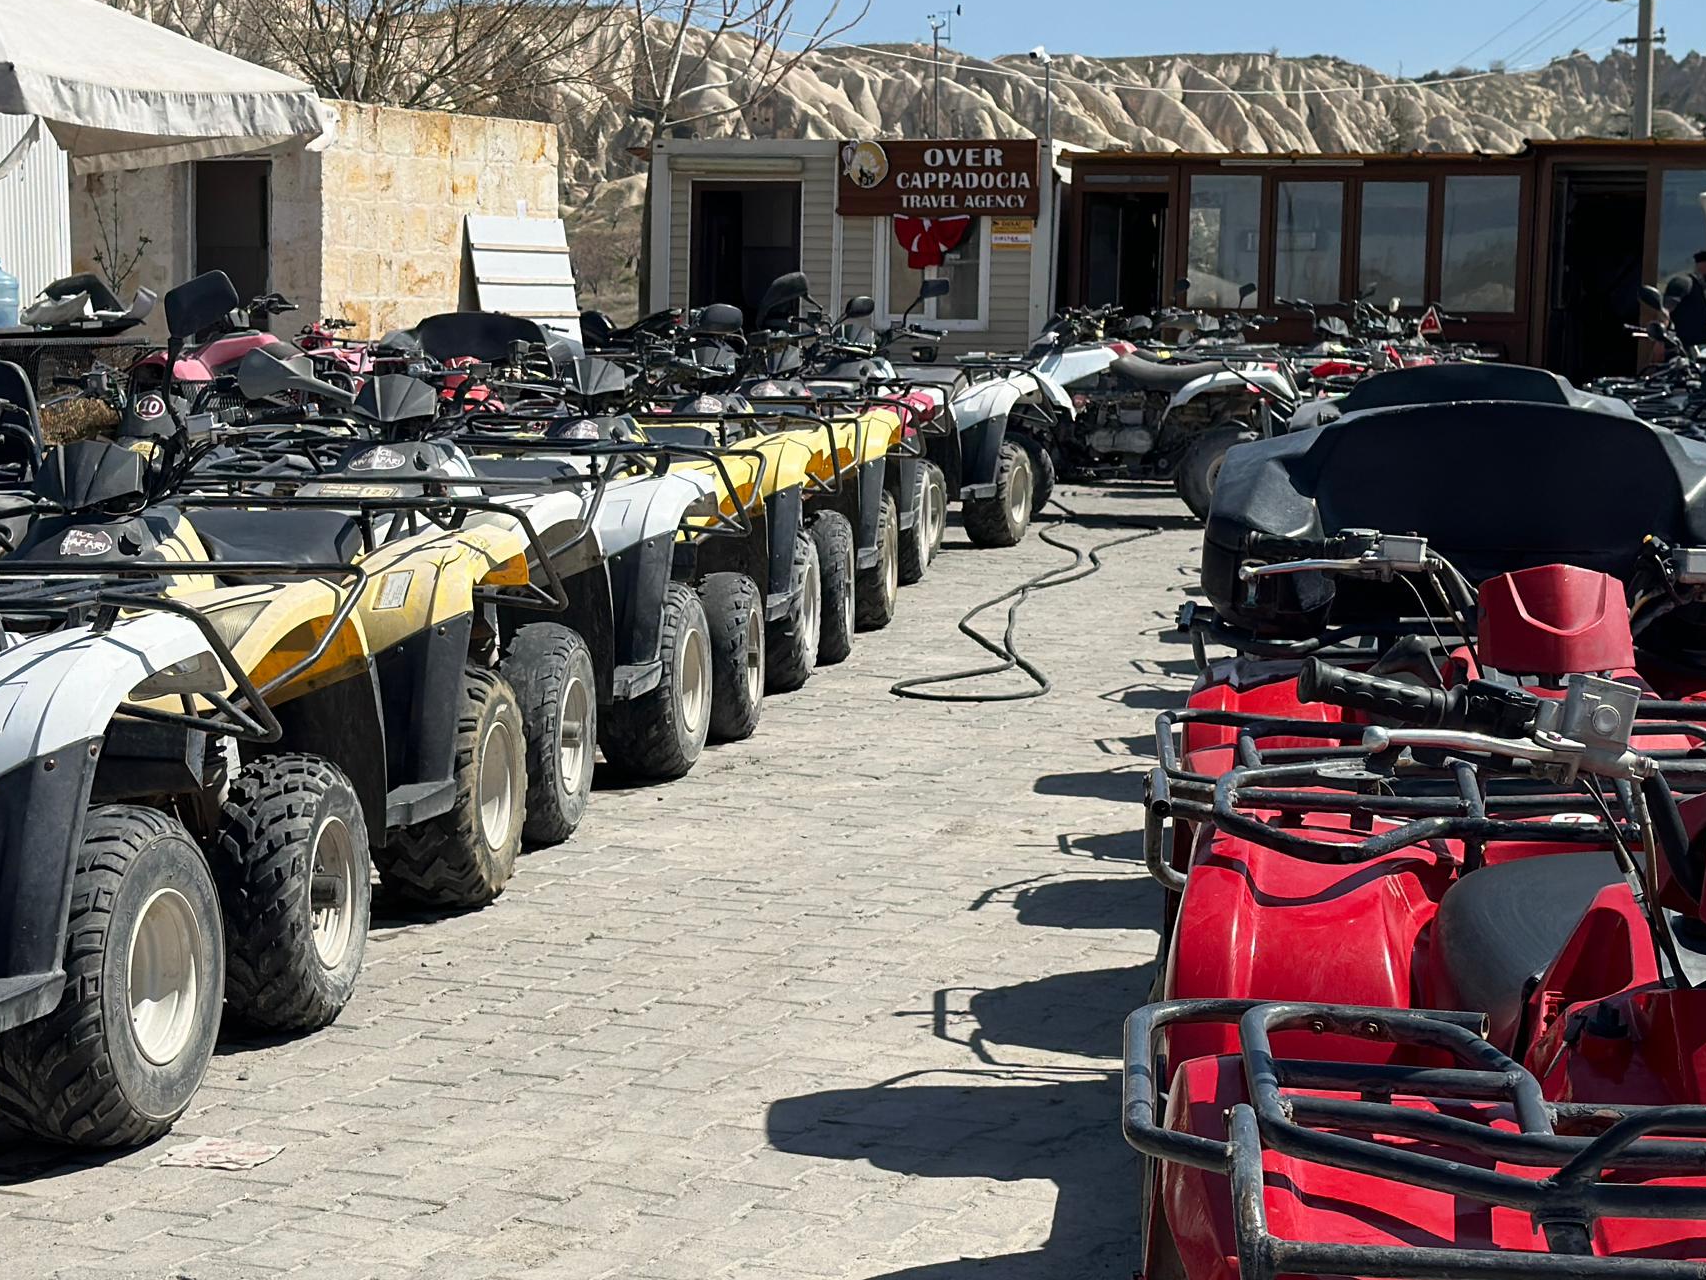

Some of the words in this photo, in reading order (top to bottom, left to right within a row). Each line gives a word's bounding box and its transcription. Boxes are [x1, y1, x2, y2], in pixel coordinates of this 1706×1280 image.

[923, 148, 1003, 167] OVER
[896, 172, 1030, 189] CAPPADOCIA
[901, 195, 960, 208] TRAVEL
[964, 195, 1027, 209] AGENCY
[140, 400, 160, 413] 10
